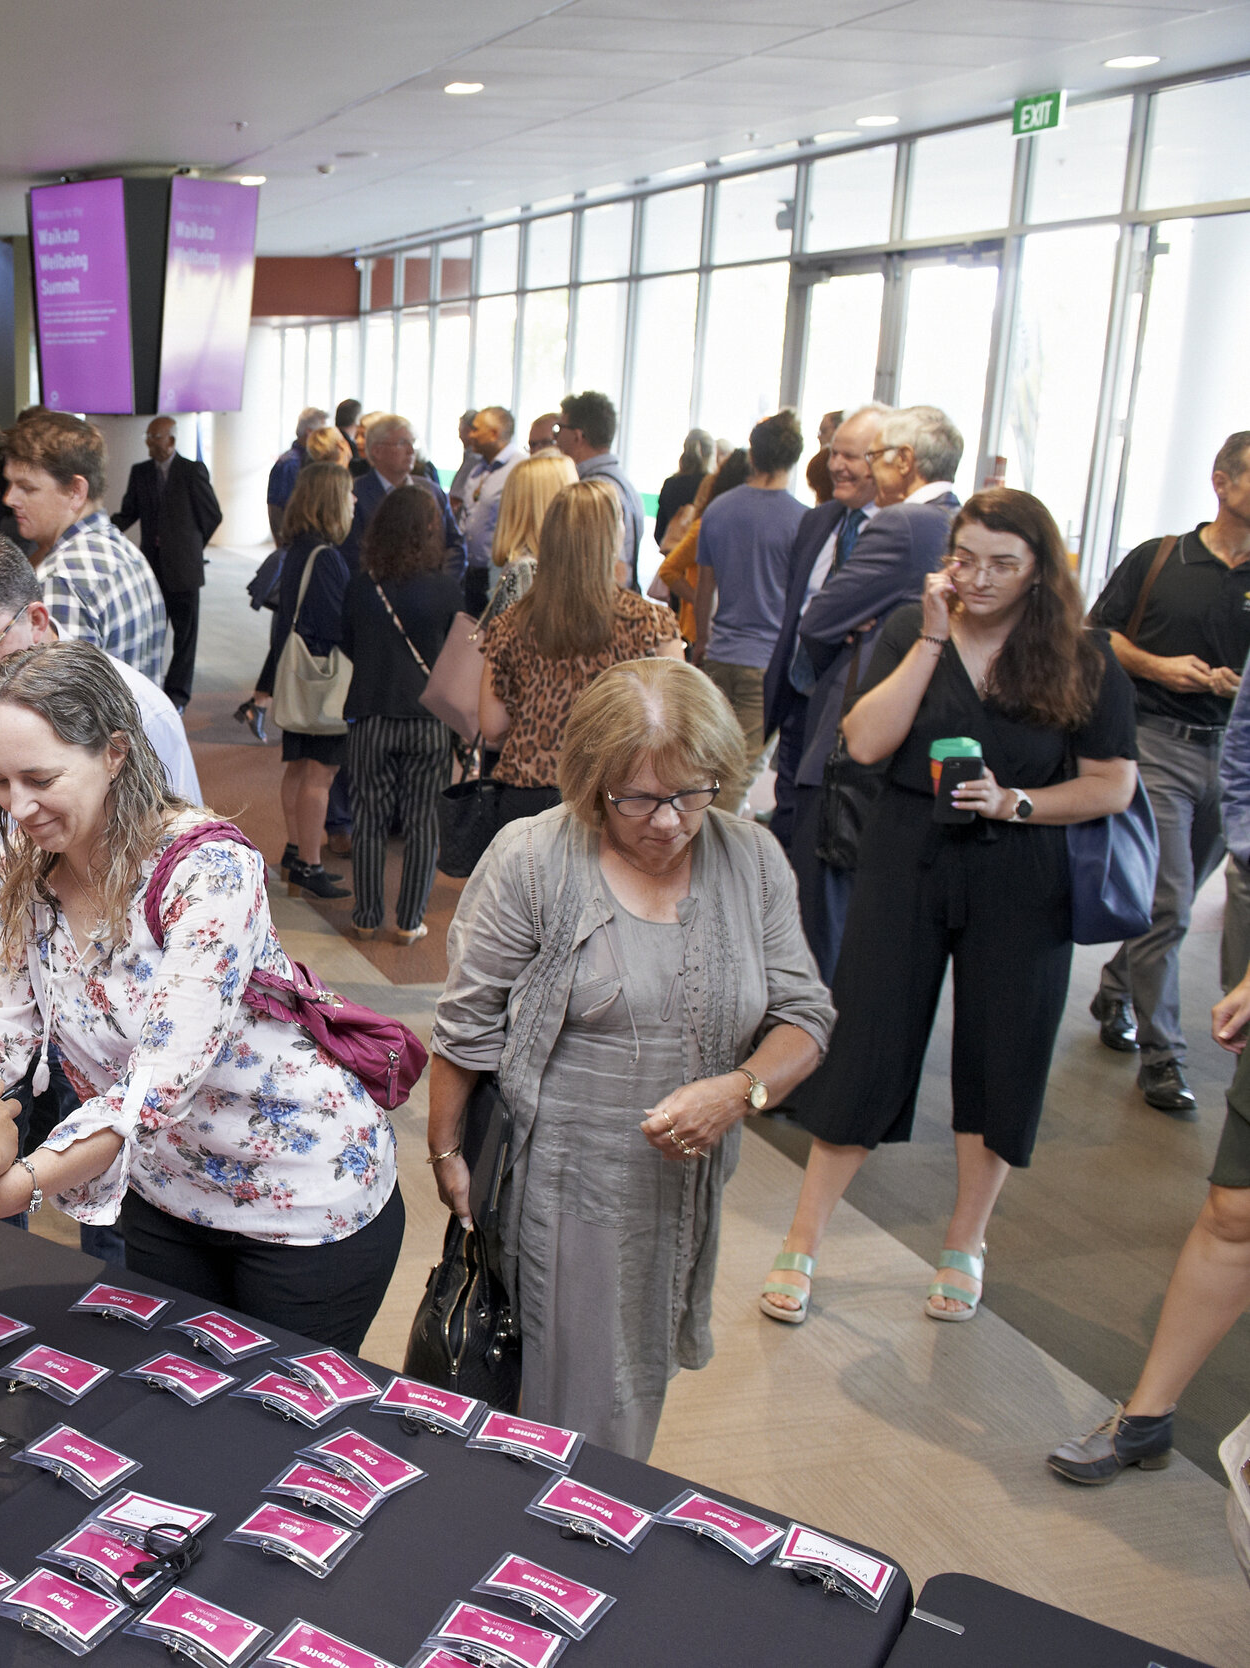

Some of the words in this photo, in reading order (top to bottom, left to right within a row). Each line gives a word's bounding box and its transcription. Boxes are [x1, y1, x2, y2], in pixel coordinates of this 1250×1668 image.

[1019, 100, 1053, 131] EXIT
[38, 227, 80, 246] Waikato
[175, 220, 216, 241] Waikato
[39, 251, 89, 272] Wellbeing
[174, 246, 221, 272] Wellbeing
[41, 276, 80, 296] Summit
[109, 1294, 134, 1306] Katie
[204, 1320, 238, 1340] Stephen
[44, 1360, 70, 1375] Craig
[164, 1365, 200, 1380] Andrew
[275, 1384, 310, 1401] Debbie
[407, 1392, 447, 1408] Morgan
[506, 1427, 545, 1441] James
[63, 1444, 96, 1462] Jessie
[352, 1448, 379, 1466] Chris
[307, 1476, 351, 1496] Michael
[570, 1496, 613, 1520] Watene
[277, 1521, 305, 1536] Nick
[704, 1510, 741, 1529] Susan
[100, 1547, 121, 1561] Stu
[521, 1573, 568, 1597] Awhina
[47, 1592, 73, 1610] Tony
[182, 1611, 217, 1633] Darcy
[480, 1624, 515, 1643] Chris
[299, 1645, 349, 1668] harlotte
